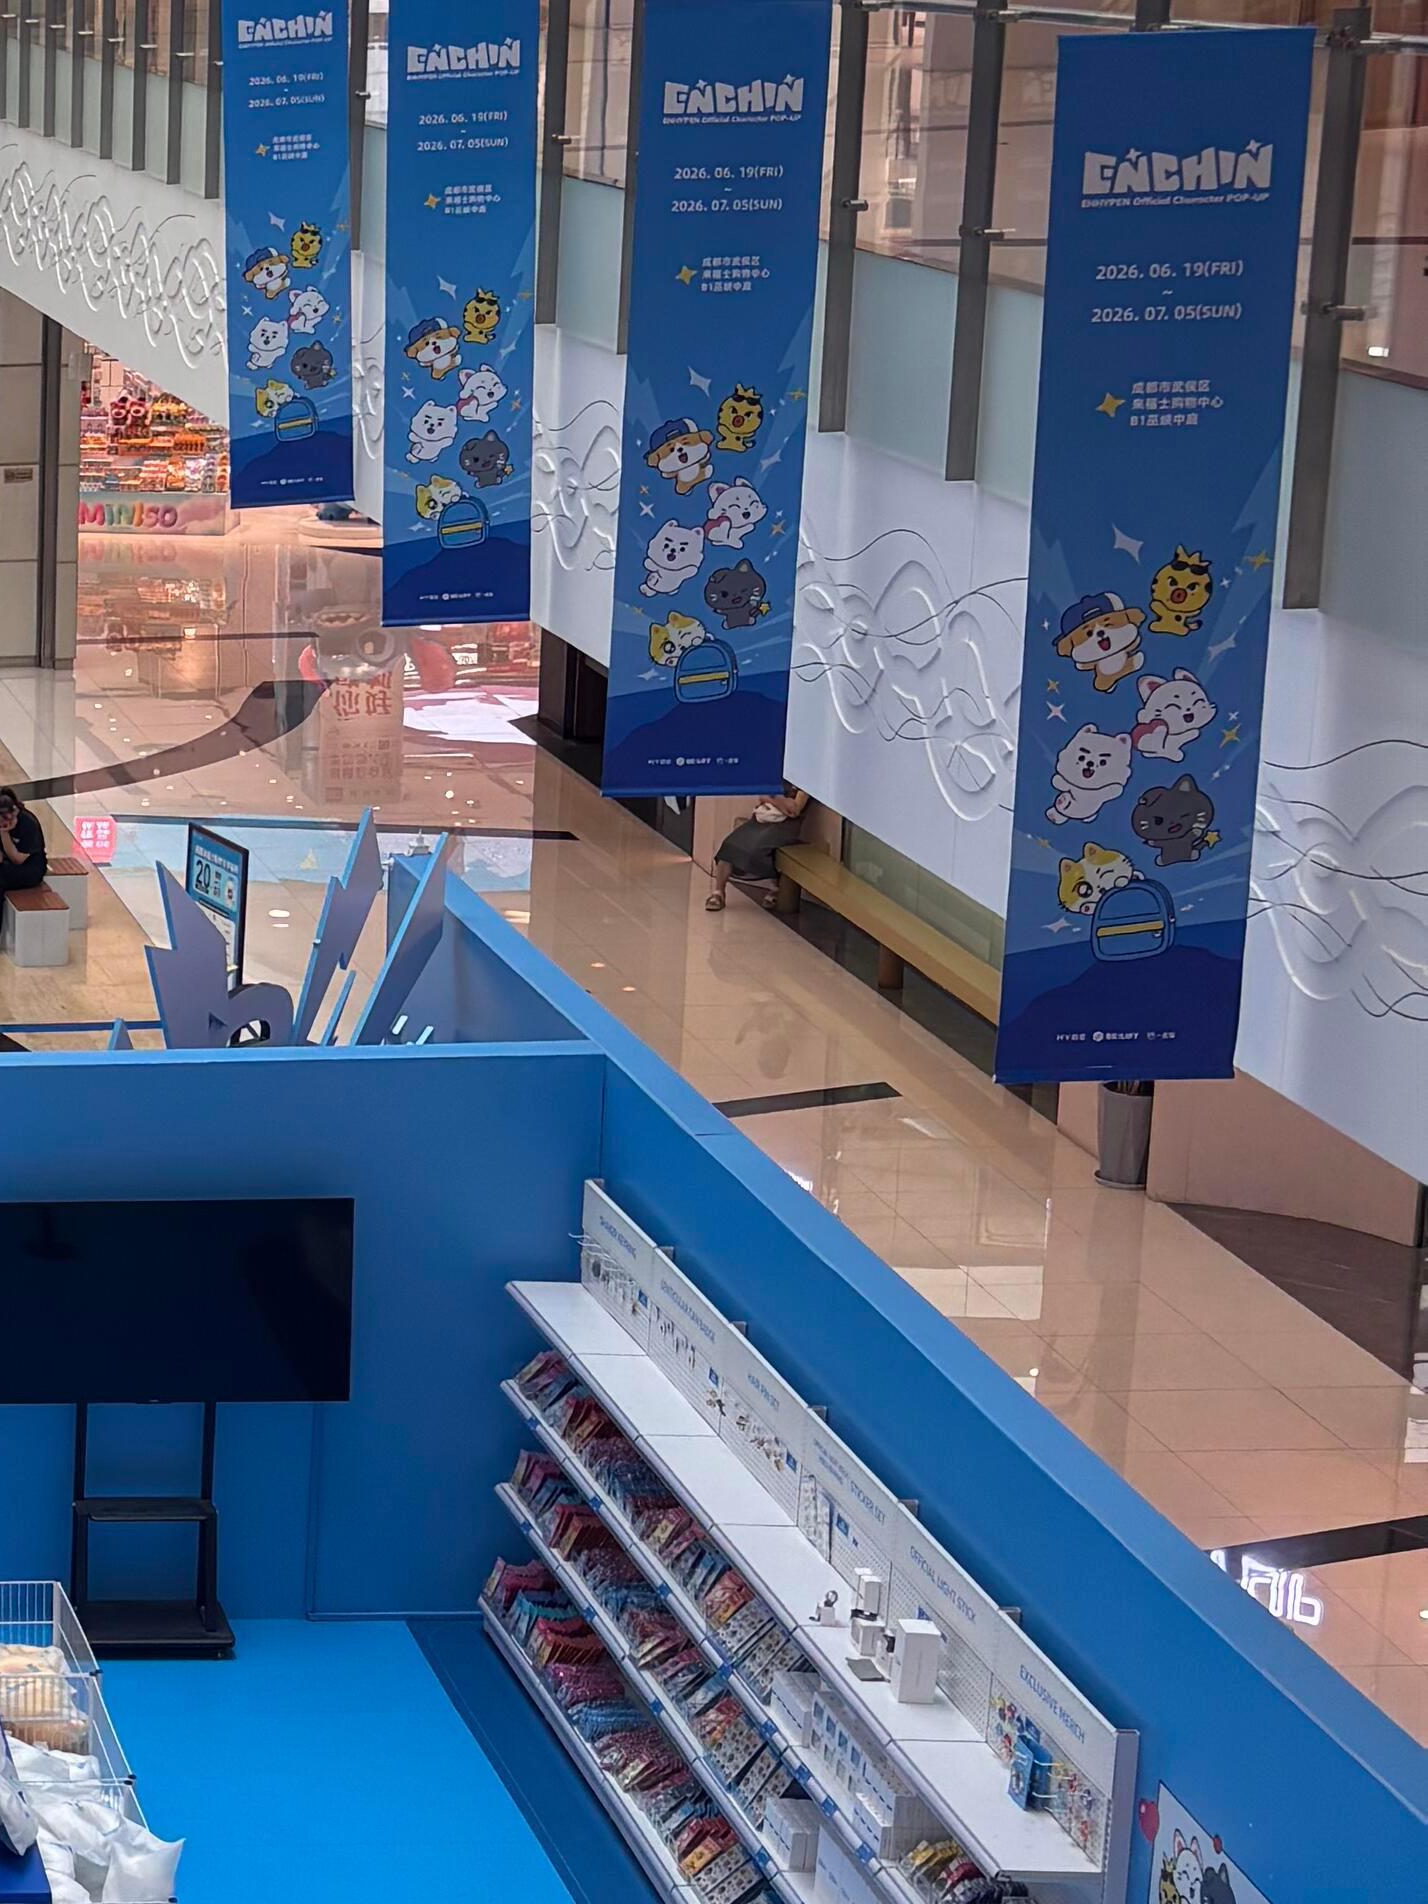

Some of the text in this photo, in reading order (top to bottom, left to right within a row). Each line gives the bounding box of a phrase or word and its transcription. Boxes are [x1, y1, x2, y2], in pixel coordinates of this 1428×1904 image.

[238, 10, 333, 43] ENCHIN
[407, 37, 520, 73] ENCHIN
[664, 74, 804, 114] ENCHIN
[1083, 140, 1273, 194] ENCHIN
[1096, 260, 1244, 280] 2026. 06. 19(FRI)
[1092, 303, 1242, 322] 2026. 07. 05(SUN)
[79, 501, 177, 528] MINISO
[910, 1546, 936, 1583] OFFICIAL
[1020, 1664, 1086, 1744] EXCLUSIVE MERCH
